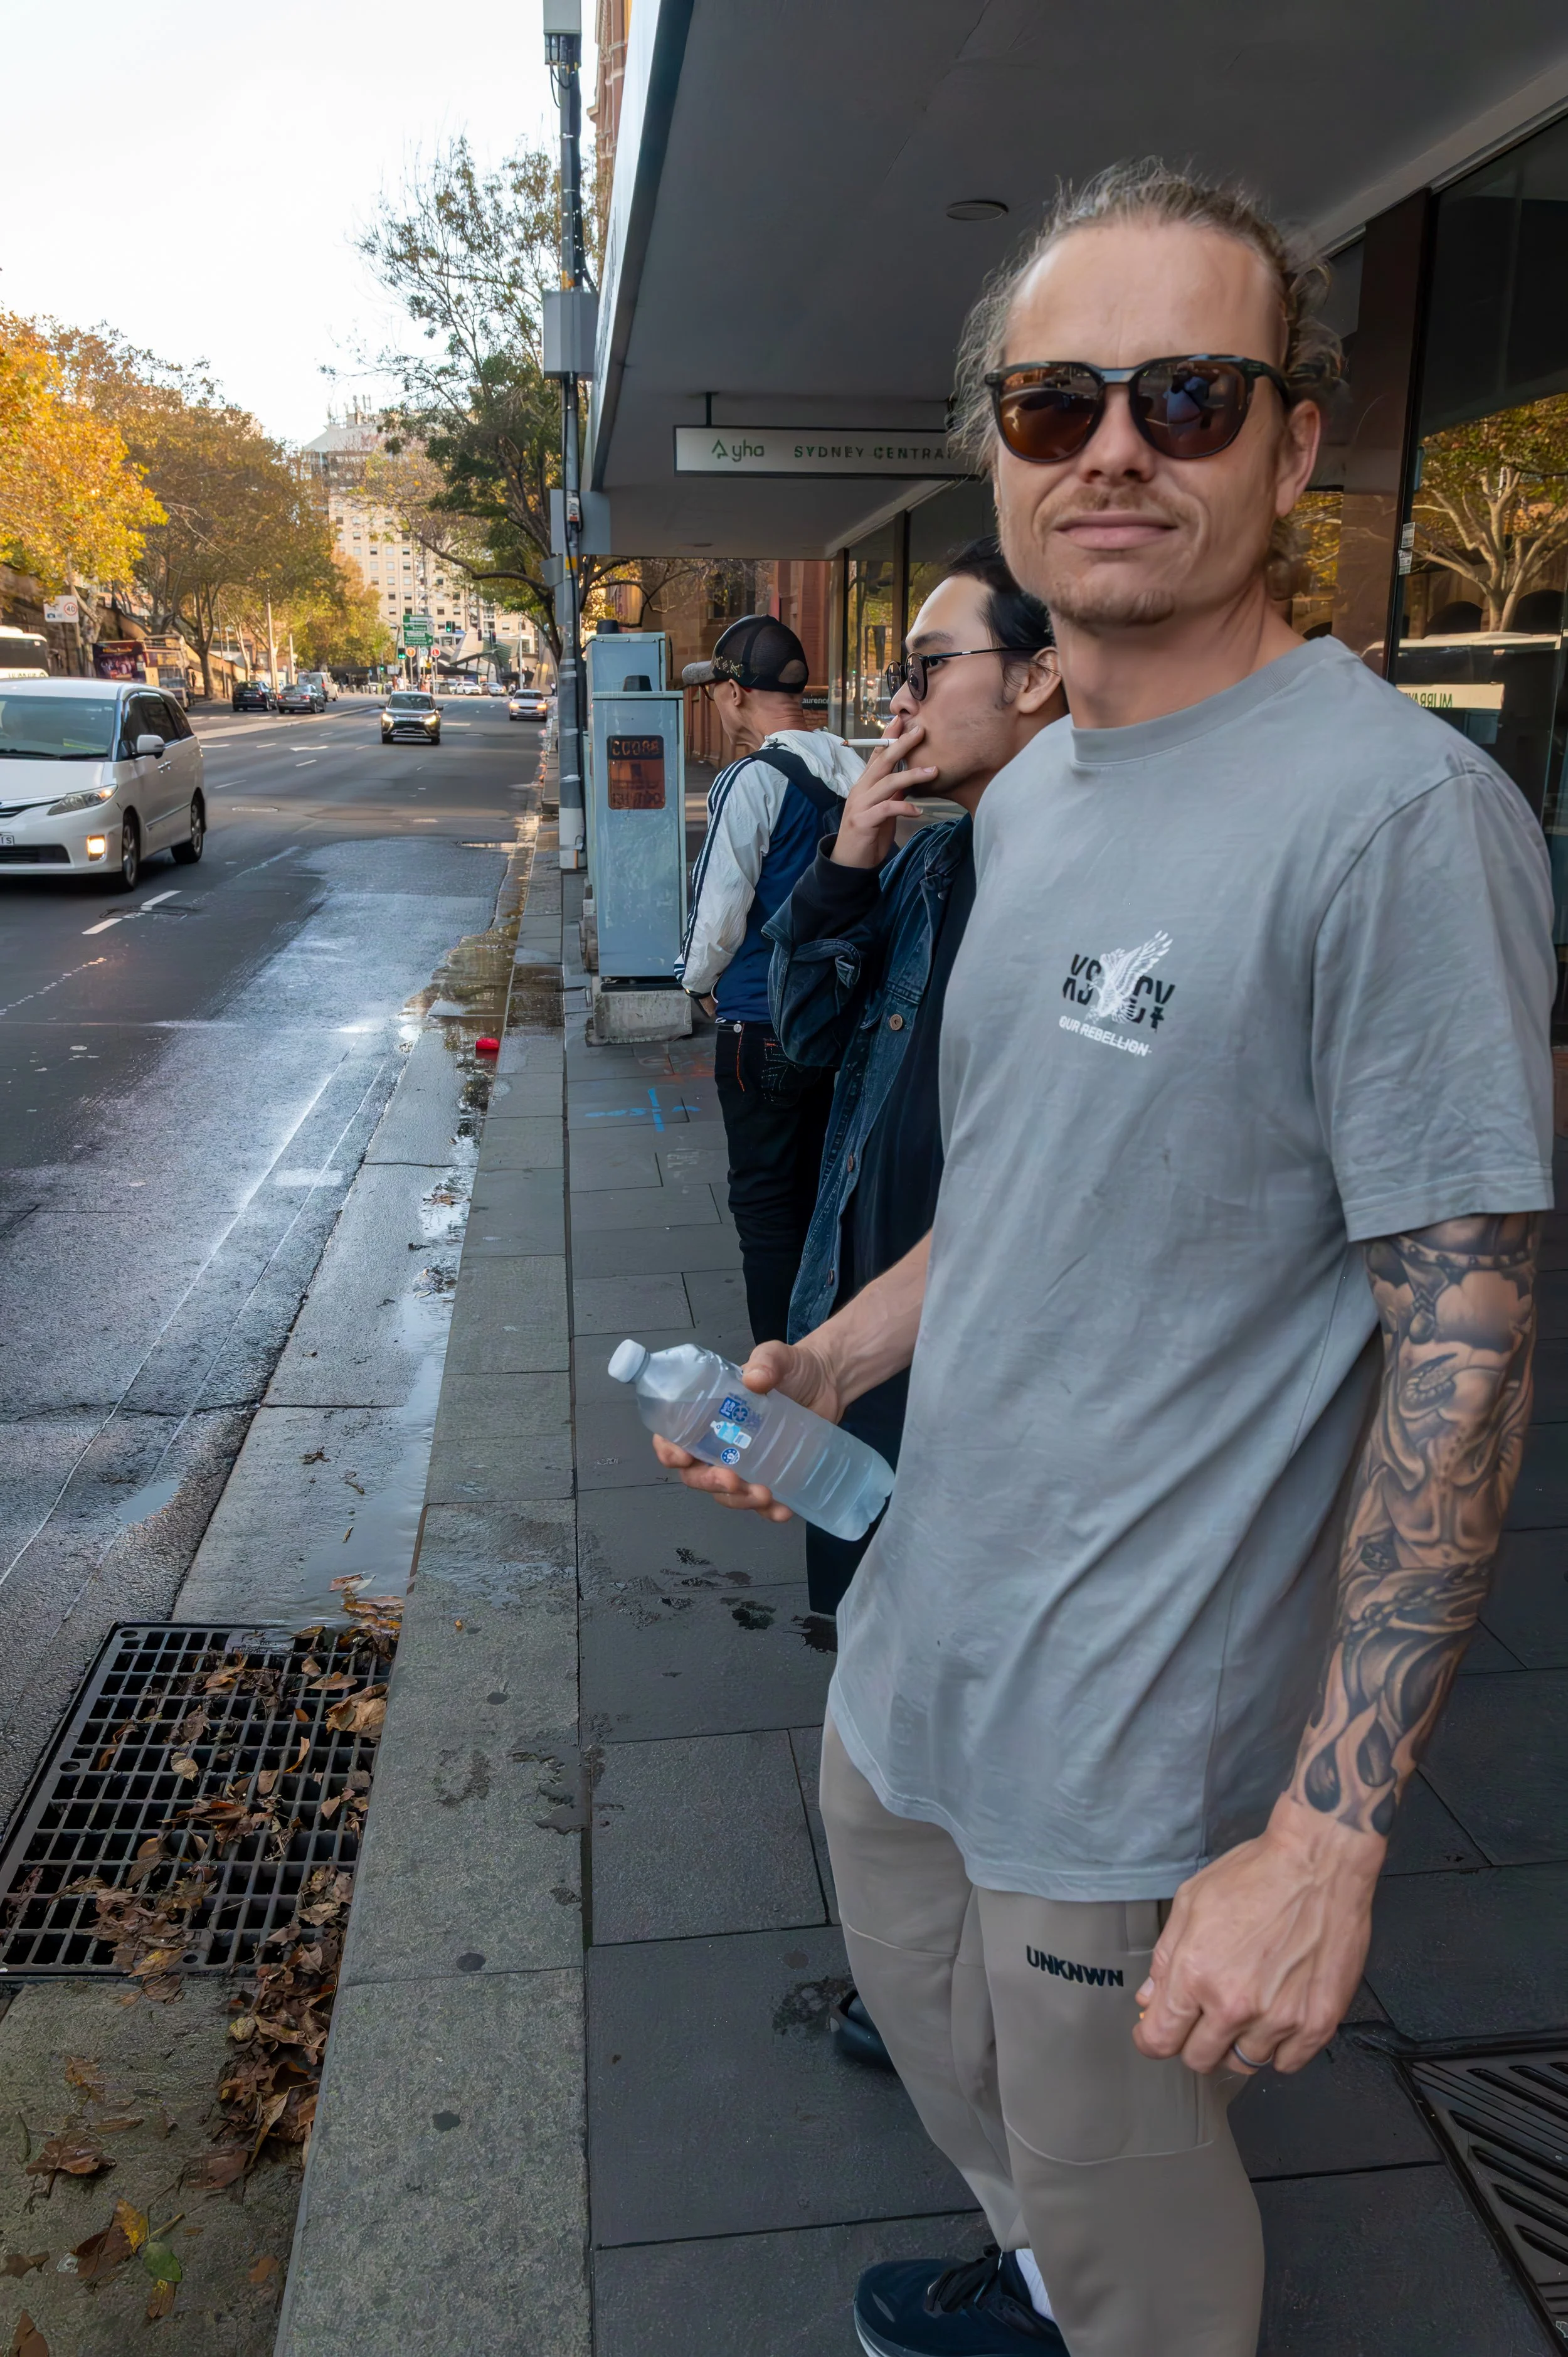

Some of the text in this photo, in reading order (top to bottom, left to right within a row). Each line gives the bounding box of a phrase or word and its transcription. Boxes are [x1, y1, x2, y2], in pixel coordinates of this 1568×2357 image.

[794, 445, 864, 458] SYDNEY
[66, 605, 75, 613] 40
[1058, 1015, 1150, 1057] OUR REBELLION
[1026, 1944, 1124, 1987] UNKNWN
